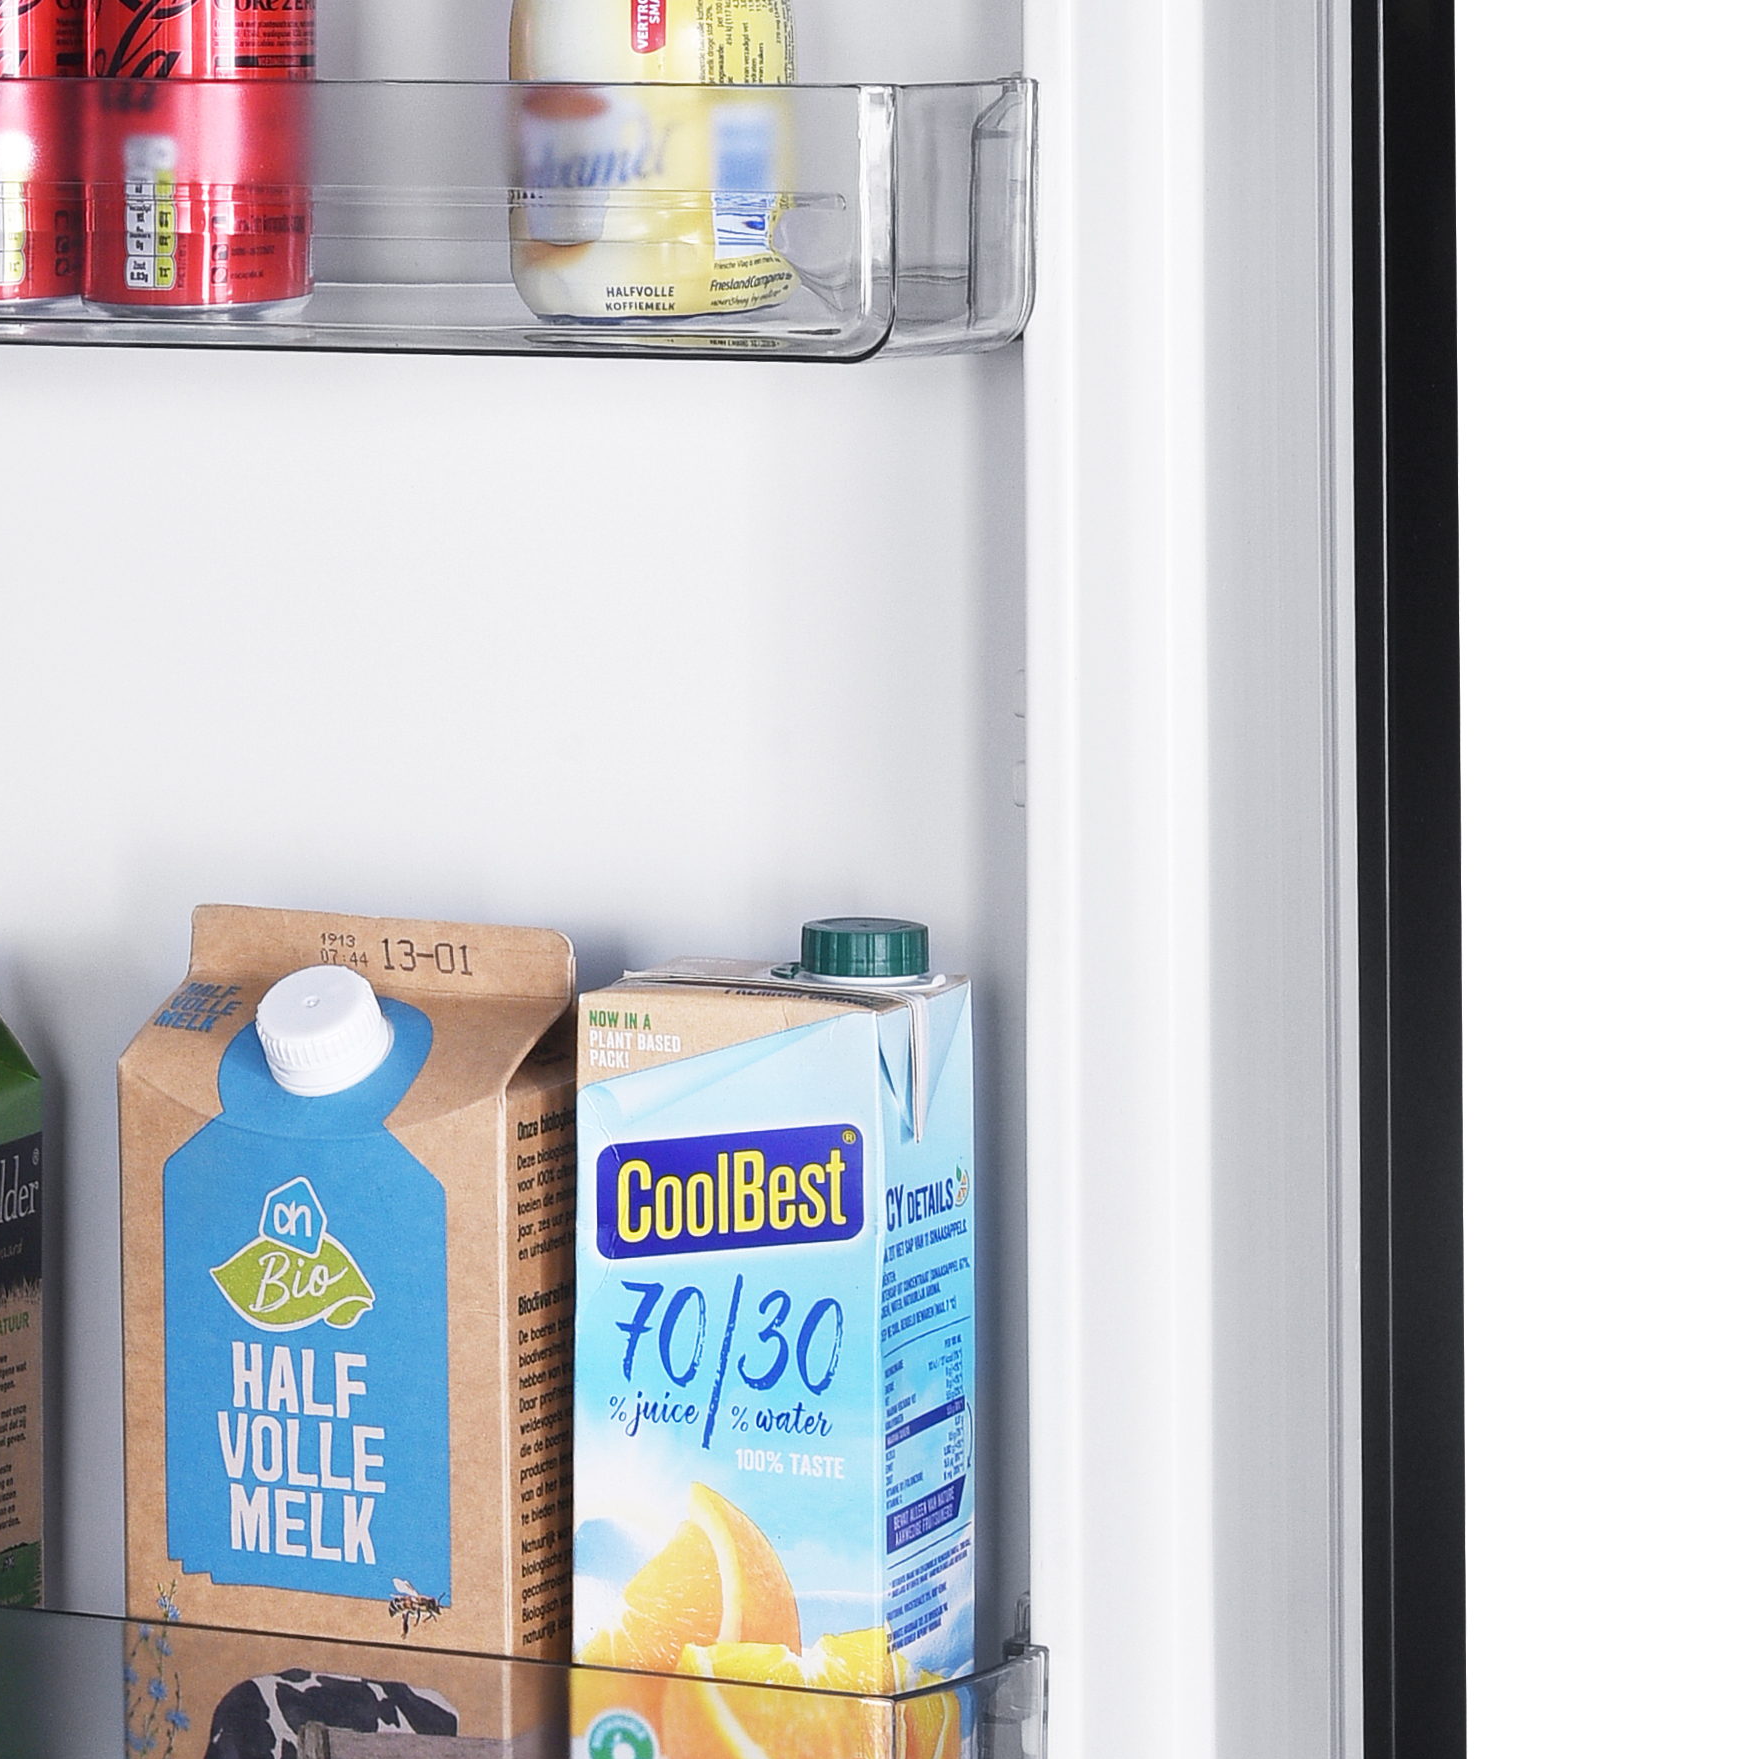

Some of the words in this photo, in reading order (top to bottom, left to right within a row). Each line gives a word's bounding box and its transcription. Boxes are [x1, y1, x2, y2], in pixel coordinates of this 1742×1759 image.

[706, 37, 714, 57] droge
[606, 286, 675, 298] HALFVOLLE
[605, 302, 675, 312] KOFFIEMELK
[319, 932, 356, 948] 1913
[381, 936, 474, 977] 13-01
[169, 994, 241, 1017] VOLLE
[154, 1009, 219, 1033] MELK
[589, 1009, 619, 1029] NOW
[624, 1011, 638, 1030] IN
[643, 1012, 652, 1030] A
[589, 1029, 632, 1051] PLANT
[637, 1033, 682, 1053] BASED
[589, 1049, 630, 1069] PACK!
[517, 1120, 539, 1141] Onze
[517, 1153, 536, 1172] Deze
[517, 1176, 535, 1194] voor
[618, 1148, 847, 1244] CoolBest
[517, 1197, 542, 1217] koeien
[885, 1184, 905, 1232] CY
[907, 1177, 954, 1225] DETAILS
[516, 1222, 537, 1243] jaar,
[518, 1246, 529, 1261] en
[250, 1250, 349, 1312] Bio
[518, 1329, 529, 1346] De
[530, 1320, 556, 1342] boeren
[231, 1341, 369, 1419] HALF
[518, 1369, 547, 1391] hebben
[609, 1394, 628, 1421] %
[626, 1391, 700, 1437] juice
[731, 1405, 750, 1433] %
[754, 1406, 834, 1438] water
[217, 1410, 387, 1494] VOLLE
[533, 1438, 544, 1453] de
[520, 1456, 558, 1486] producten
[735, 1446, 784, 1475] 100%
[790, 1449, 846, 1480] TASTE
[229, 1483, 376, 1566] MELK
[531, 1502, 556, 1524] bieden
